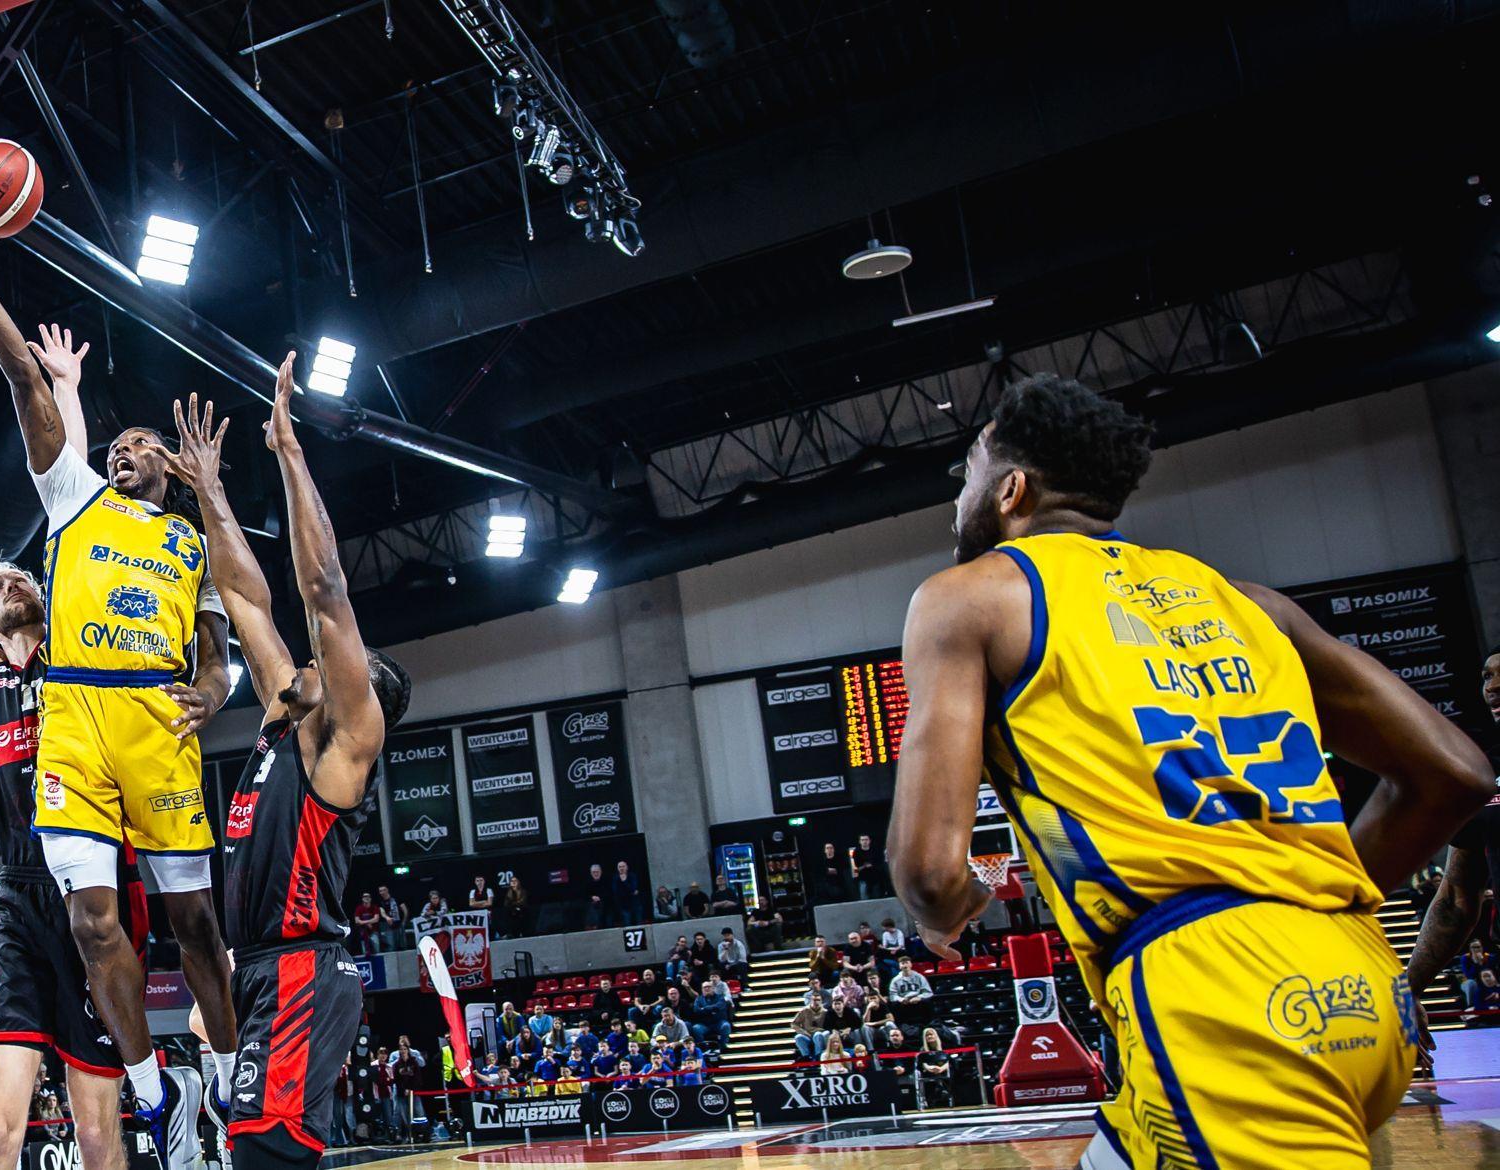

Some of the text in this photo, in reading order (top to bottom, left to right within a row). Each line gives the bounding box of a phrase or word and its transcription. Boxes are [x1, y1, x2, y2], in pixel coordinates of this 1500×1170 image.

[162, 532, 202, 572] 13
[1353, 587, 1430, 608] TASOMIX
[1361, 624, 1438, 645] TASOMIX
[1143, 656, 1257, 698] LASTER
[390, 745, 447, 763] ZŁOMEX
[1133, 706, 1344, 825] 22
[394, 784, 451, 801] ZŁOMEX
[189, 811, 203, 825] 4F
[624, 931, 643, 948] 37
[1267, 974, 1379, 1041] Grześ
[778, 1074, 868, 1109] XERO
[810, 1093, 870, 1107] SERVICE
[505, 1104, 581, 1122] NABZDYK
